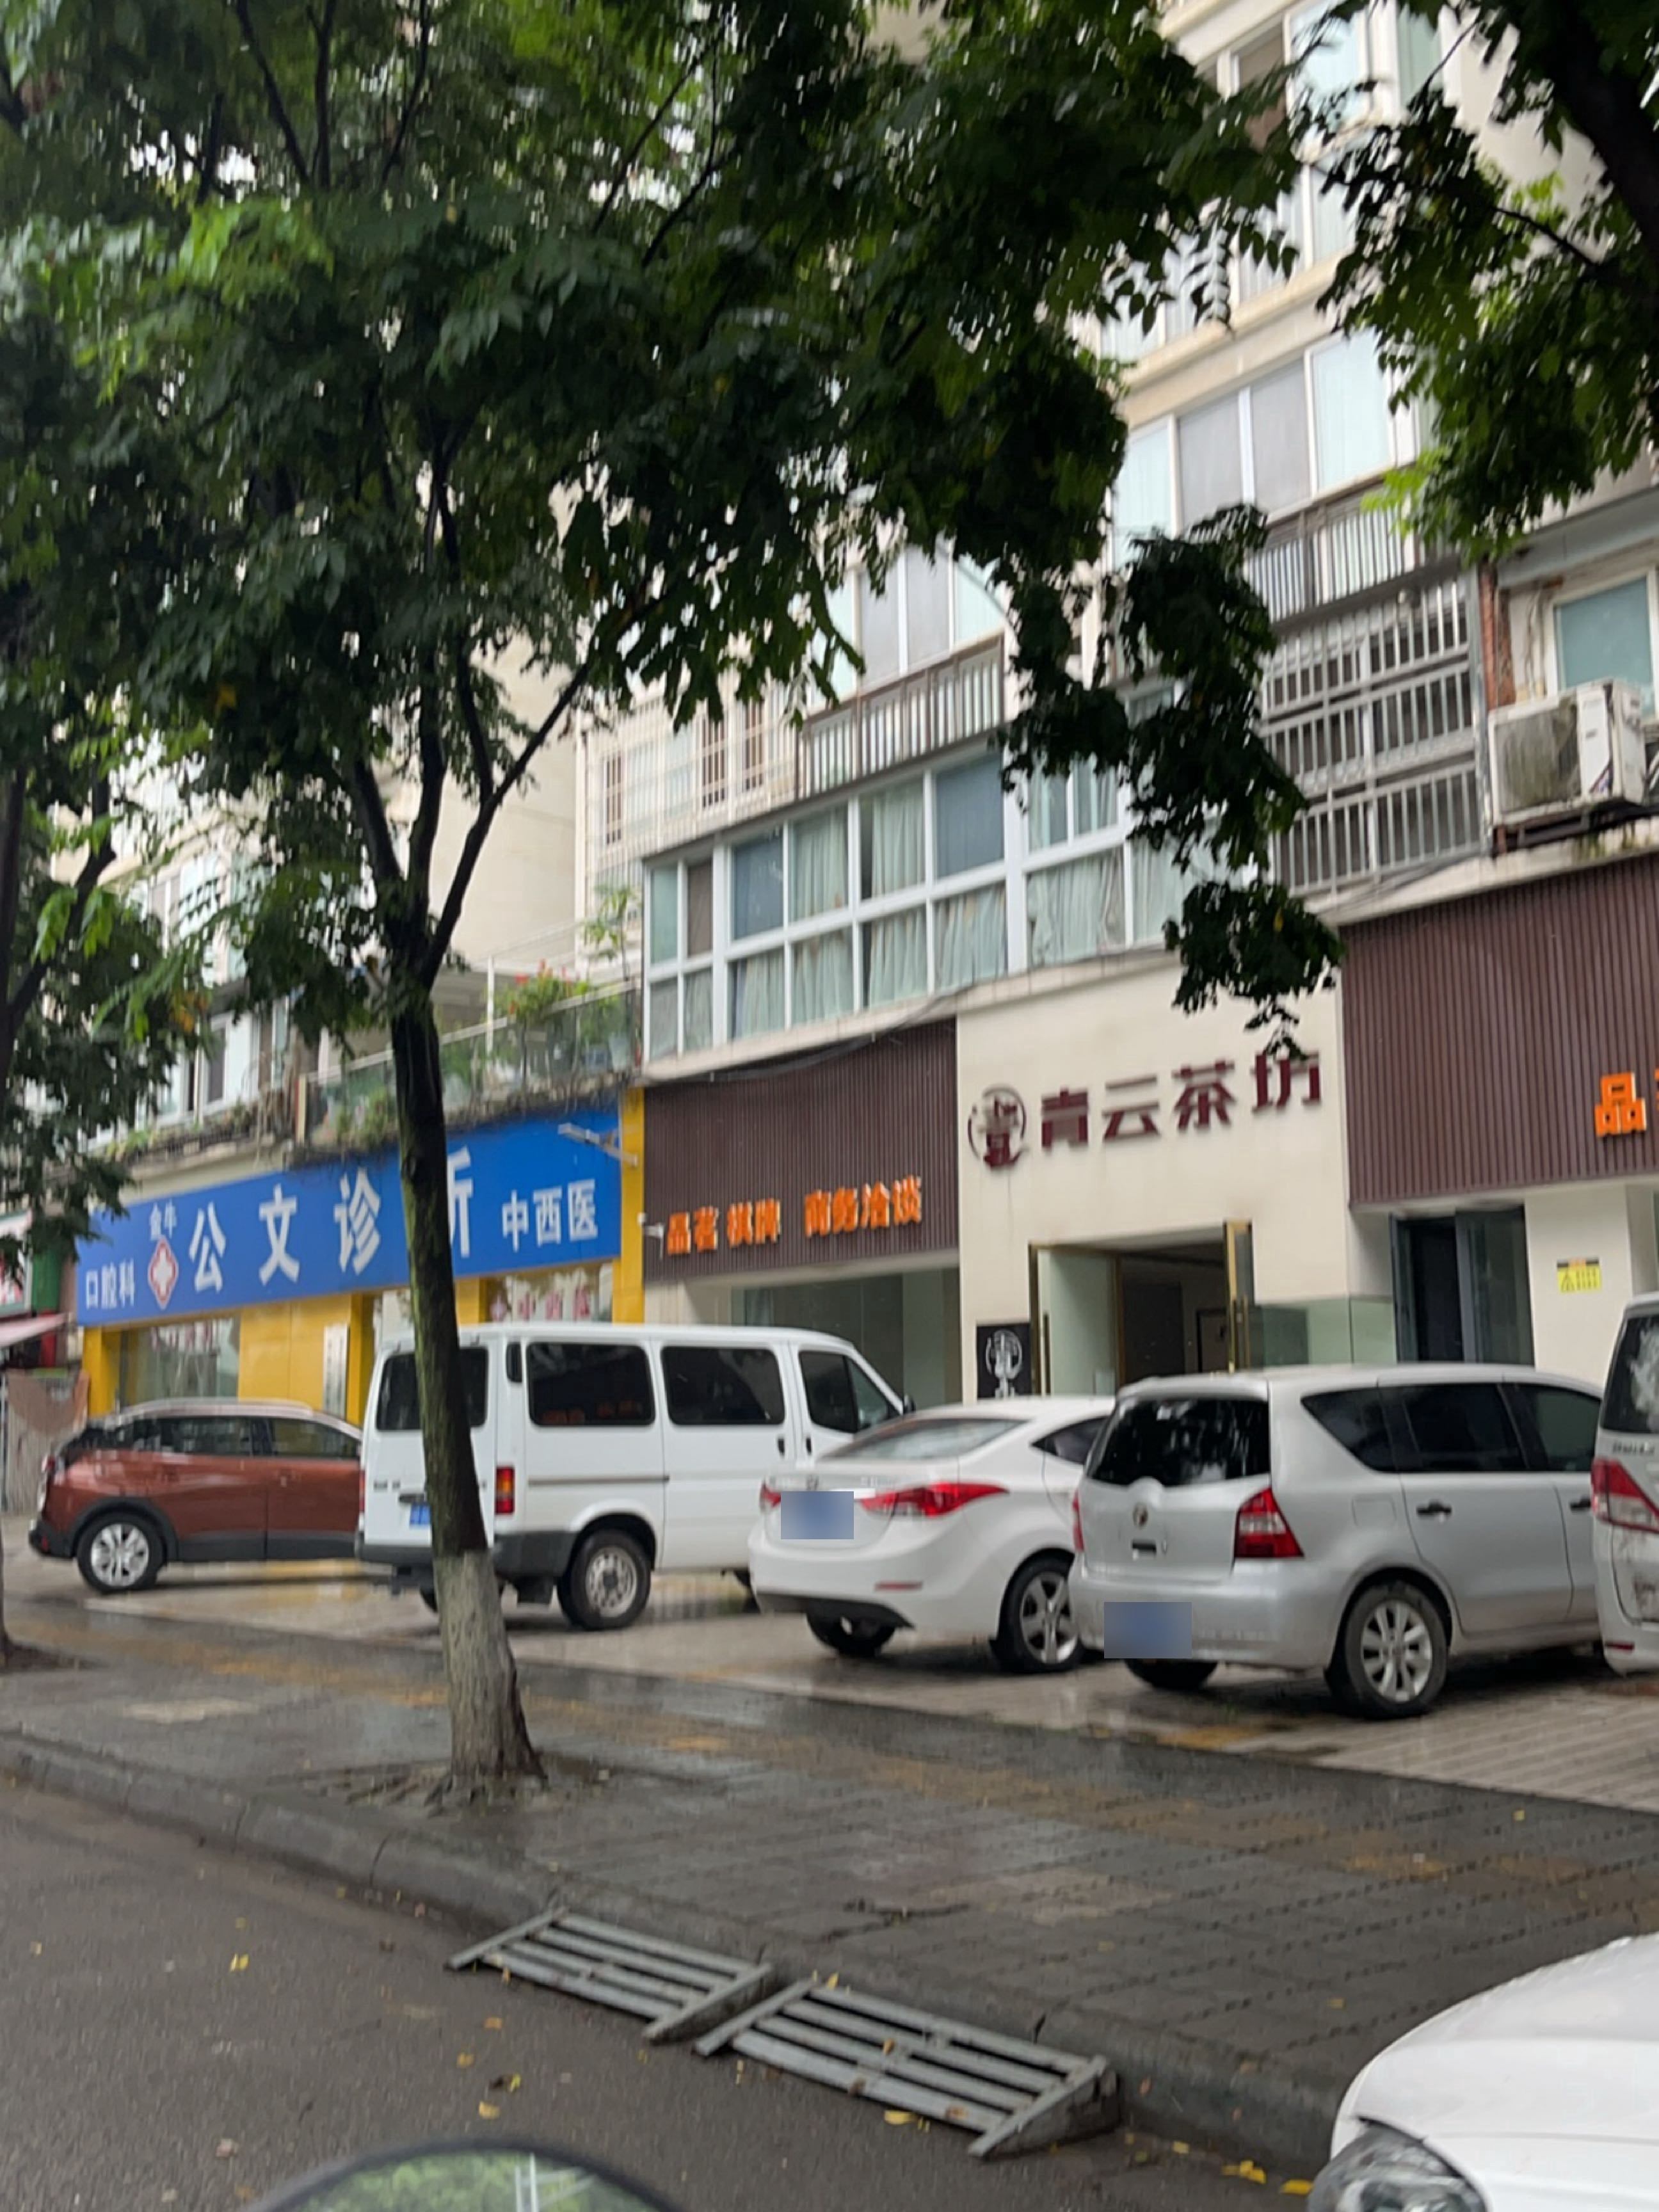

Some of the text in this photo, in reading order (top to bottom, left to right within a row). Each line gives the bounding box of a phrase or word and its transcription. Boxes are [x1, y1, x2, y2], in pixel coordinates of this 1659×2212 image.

[1594, 1071, 1659, 1137] 品
[502, 1178, 598, 1253] 中西医
[804, 1174, 922, 1238] 商务洽谈
[85, 1258, 135, 1309] 口腔科
